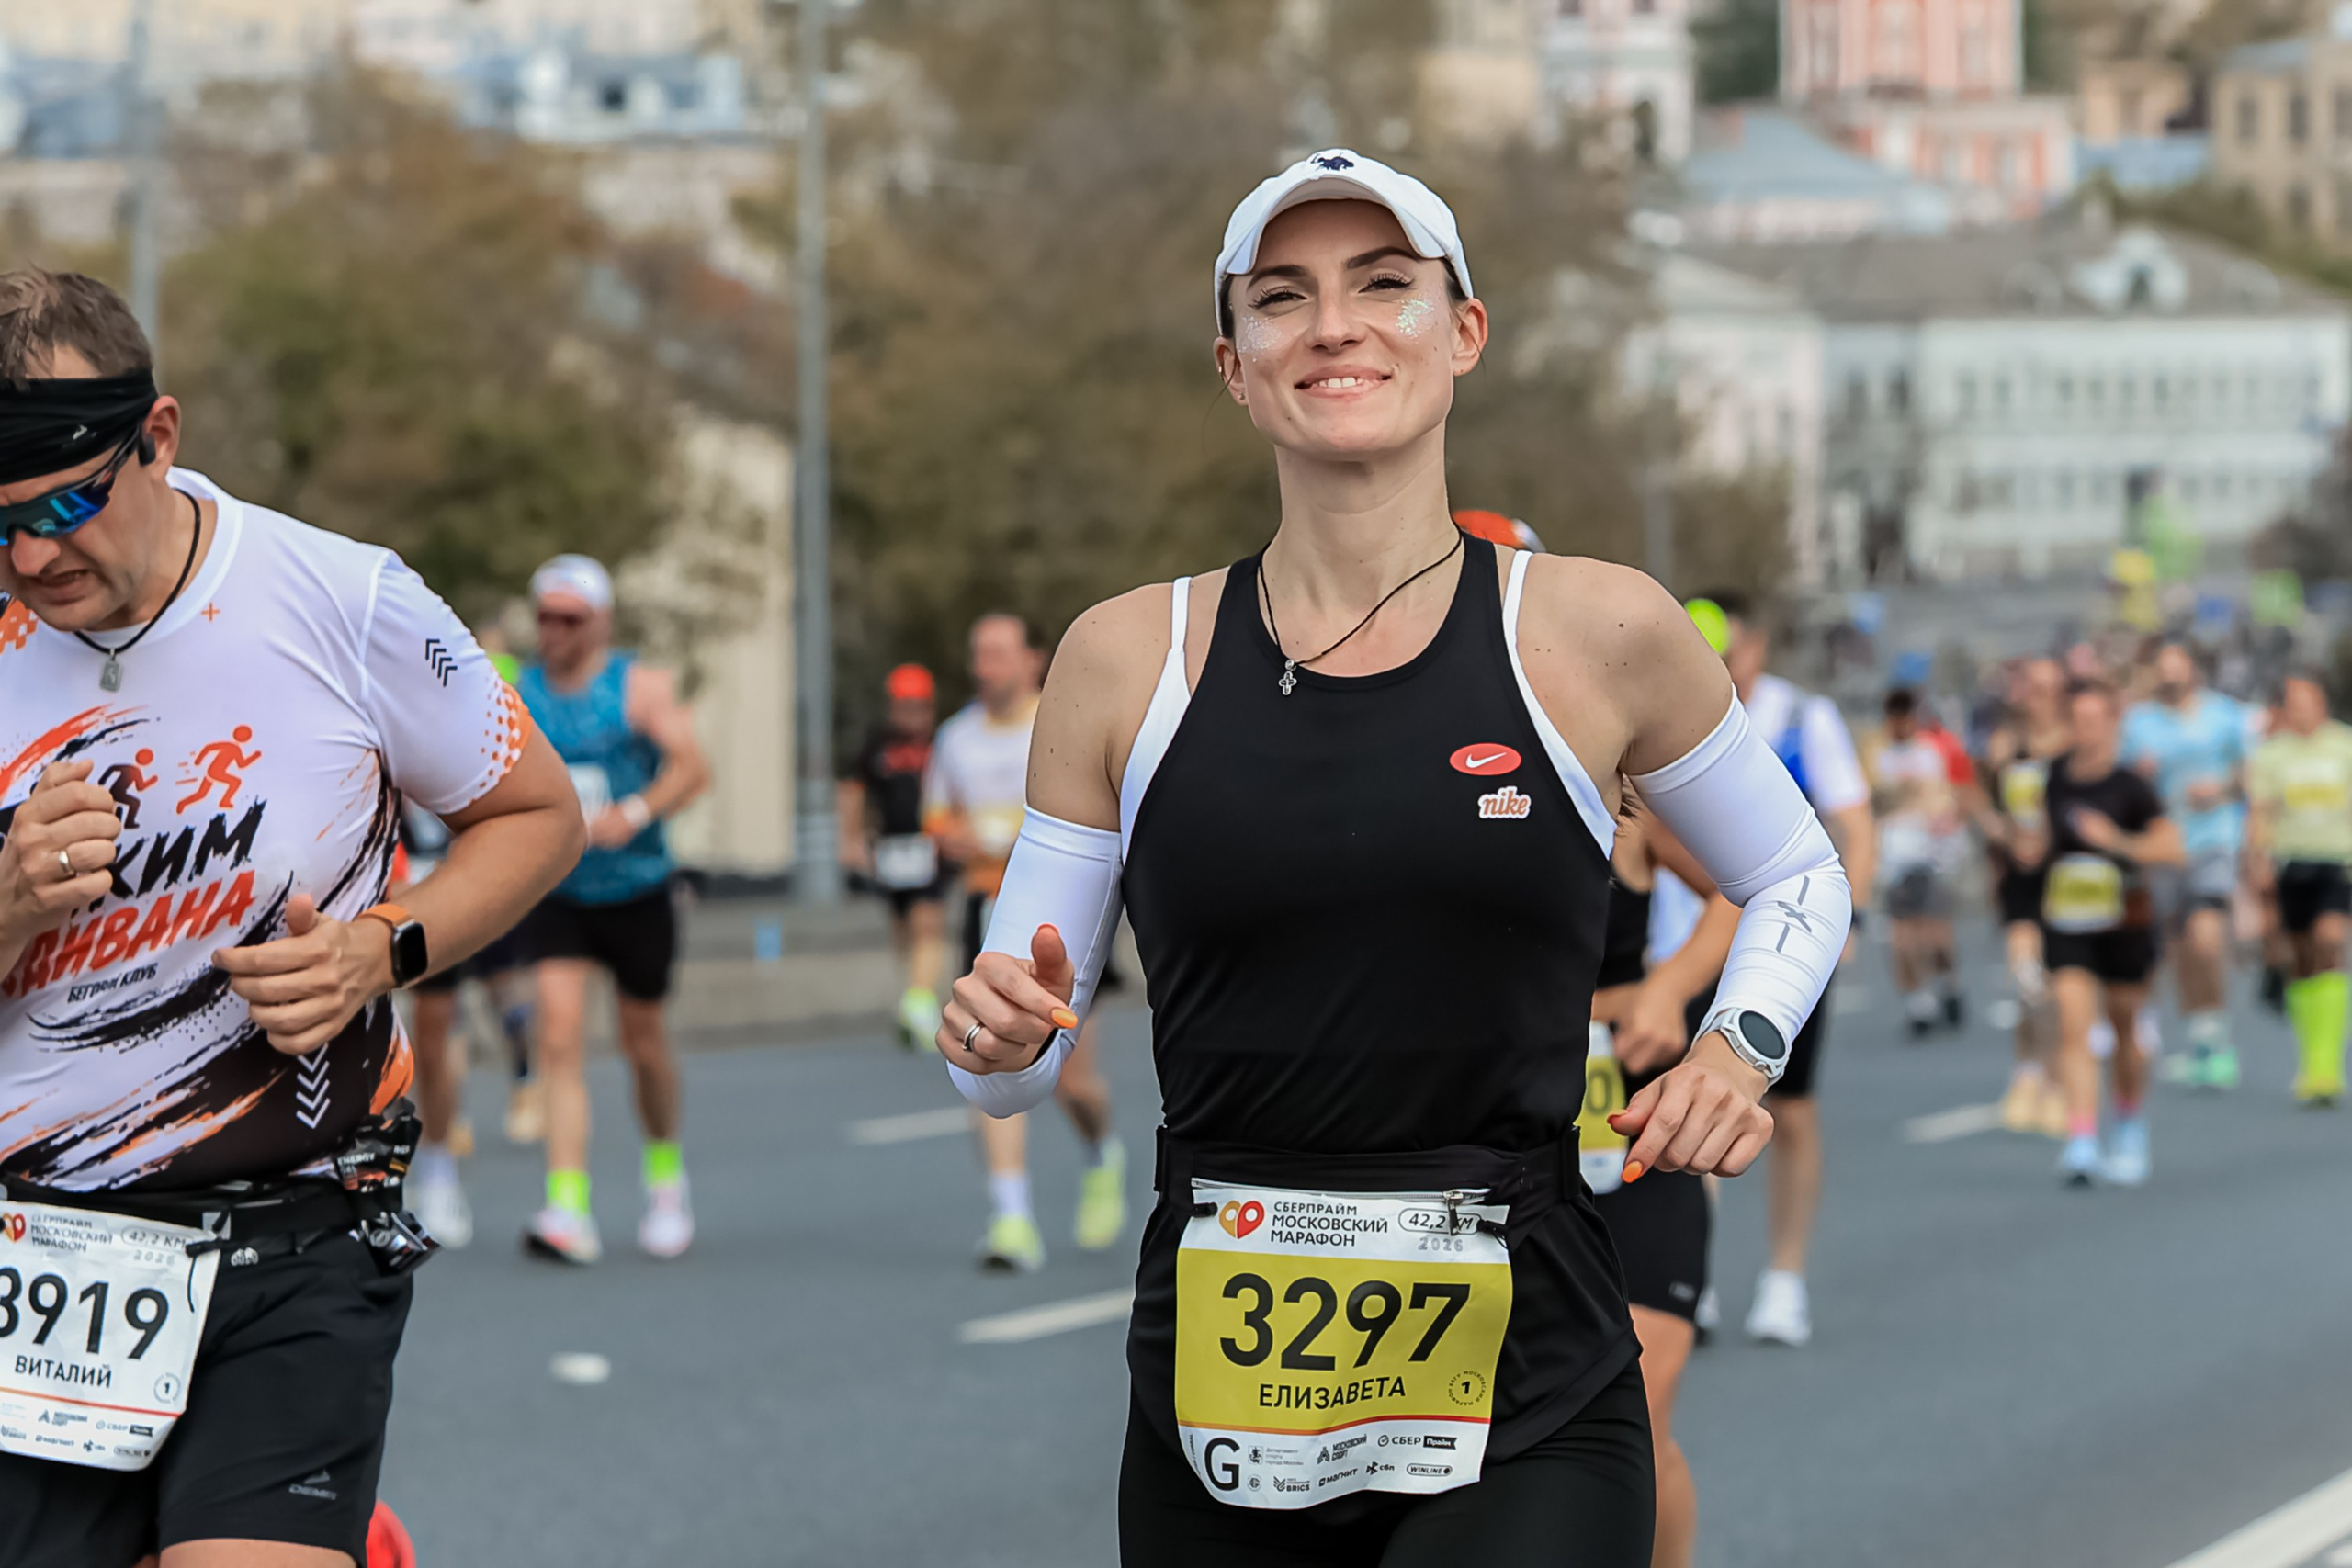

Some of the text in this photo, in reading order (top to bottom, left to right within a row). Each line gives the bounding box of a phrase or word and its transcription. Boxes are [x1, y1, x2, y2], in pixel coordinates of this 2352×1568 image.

[1481, 789, 1530, 817] nike
[119, 962, 159, 987] КЛУБ
[1273, 1201, 1358, 1215] СБЕРПРАЙМ
[1272, 1214, 1388, 1233] МОСКОВСКИЙ
[1408, 1213, 1447, 1230] 42,2
[30, 1224, 113, 1245] МОСКОВСКИЙ
[1270, 1229, 1355, 1247] МАРАФОН
[31, 1235, 87, 1253] МАРАФОН
[1418, 1236, 1464, 1252] 2026
[1219, 1272, 1471, 1371] 3297
[15, 1355, 112, 1389] ВИТАЛИЙ
[1259, 1376, 1407, 1409] ЕЛИЗАВЕТА
[1461, 1381, 1471, 1395] 1
[1391, 1436, 1421, 1446] СБЕР
[1204, 1437, 1240, 1492] G
[1410, 1466, 1443, 1475] WINLINE
[1286, 1483, 1311, 1493] BRICS
